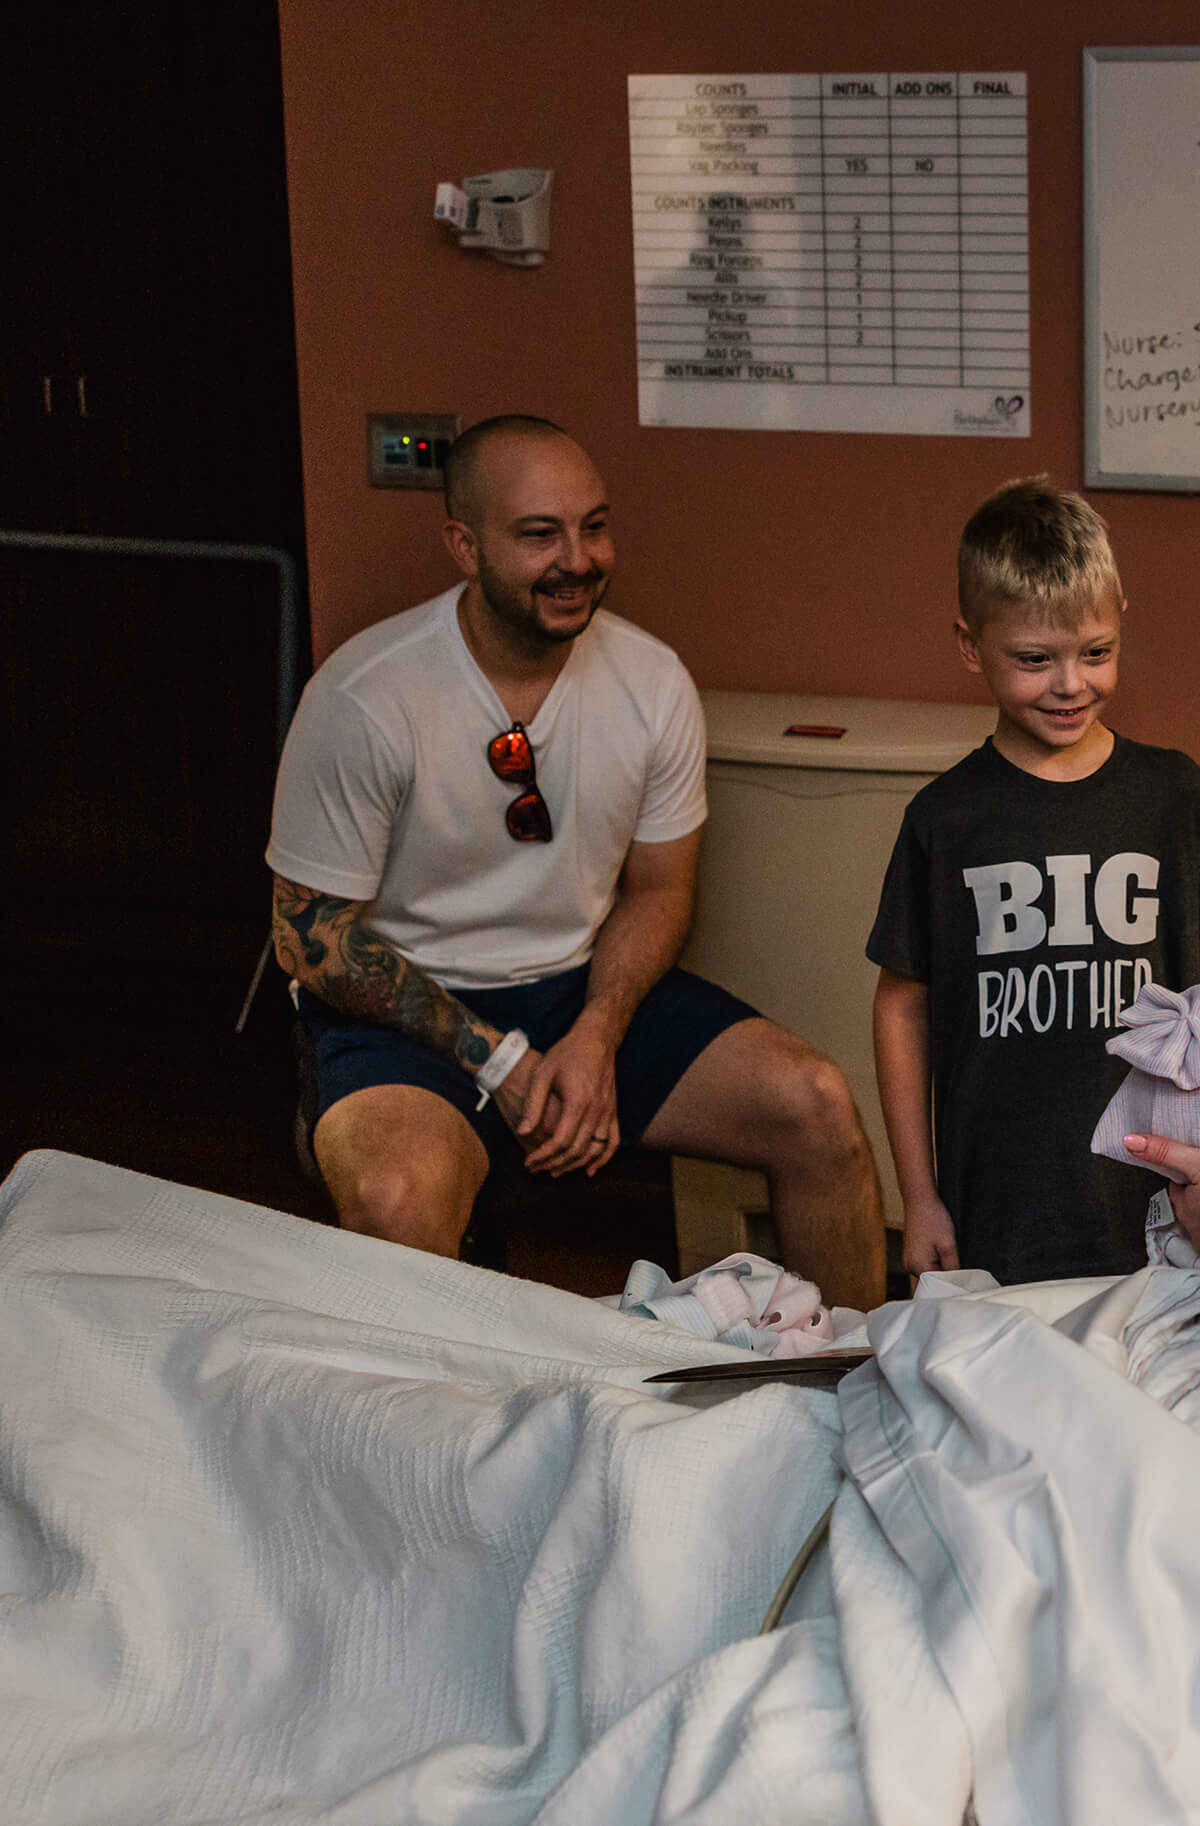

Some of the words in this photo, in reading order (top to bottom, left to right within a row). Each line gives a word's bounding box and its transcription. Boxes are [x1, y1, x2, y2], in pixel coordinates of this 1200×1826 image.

[695, 82, 747, 97] COUNTS
[831, 82, 878, 96] INITIAL
[895, 82, 921, 96] ADD
[926, 82, 953, 96] ONS
[973, 81, 1012, 95] FINAL
[710, 102, 759, 117] Sponges
[719, 122, 769, 138] Sponges
[698, 140, 747, 154] Needles
[845, 159, 868, 174] YES
[914, 158, 935, 172] NO
[653, 196, 706, 212] COUNTS
[708, 196, 796, 212] INSTRUMENTS
[853, 215, 862, 230] 2
[686, 291, 728, 304] Needle
[708, 309, 747, 325] Pickup
[705, 327, 751, 342] Scissors
[855, 330, 864, 345] 2
[664, 364, 742, 379] INSTRUMENT
[747, 365, 795, 380] TOTALS
[962, 852, 1161, 955] BIG
